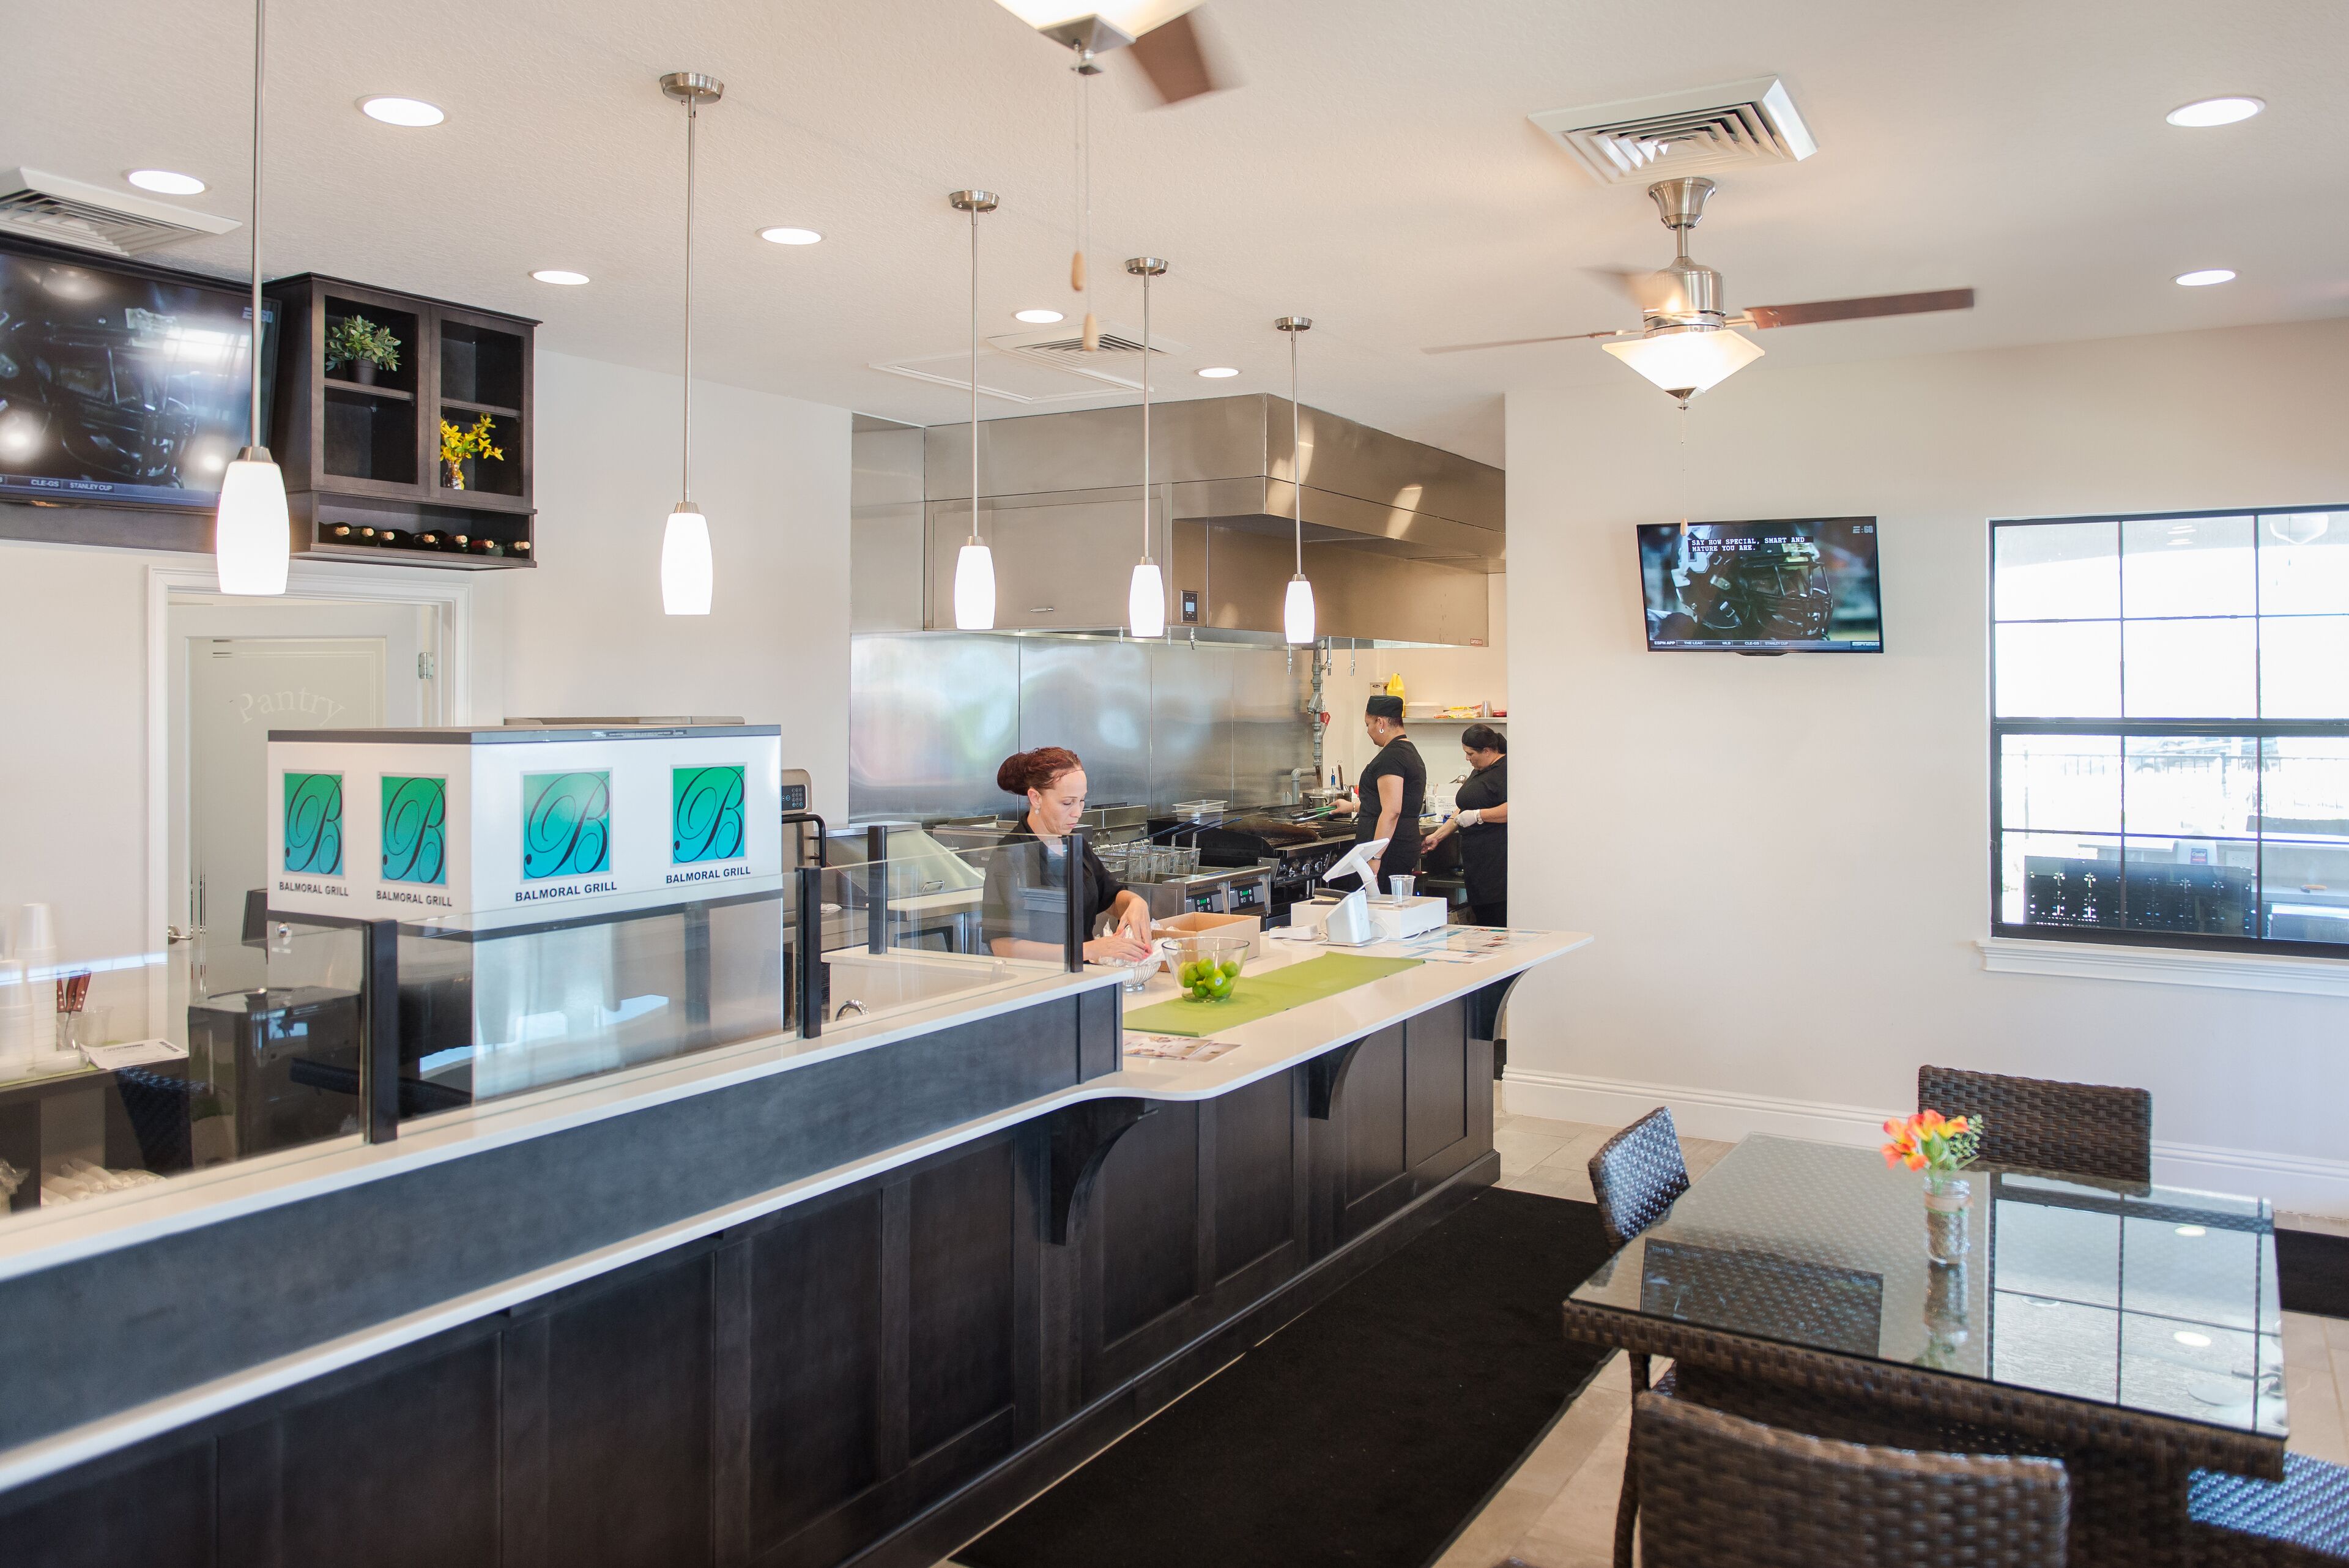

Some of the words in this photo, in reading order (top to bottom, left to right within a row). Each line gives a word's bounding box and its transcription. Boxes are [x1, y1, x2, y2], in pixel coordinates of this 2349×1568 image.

[239, 686, 346, 727] Pantry
[666, 870, 720, 884] BALMORAL
[722, 866, 751, 877] GRILL
[279, 881, 322, 894] BALMORAL
[325, 885, 349, 897] GRILL
[515, 886, 581, 901] BALMORAL
[584, 882, 617, 895] GRILL
[376, 890, 423, 904] BALMORAL
[426, 895, 452, 907] GRILL
